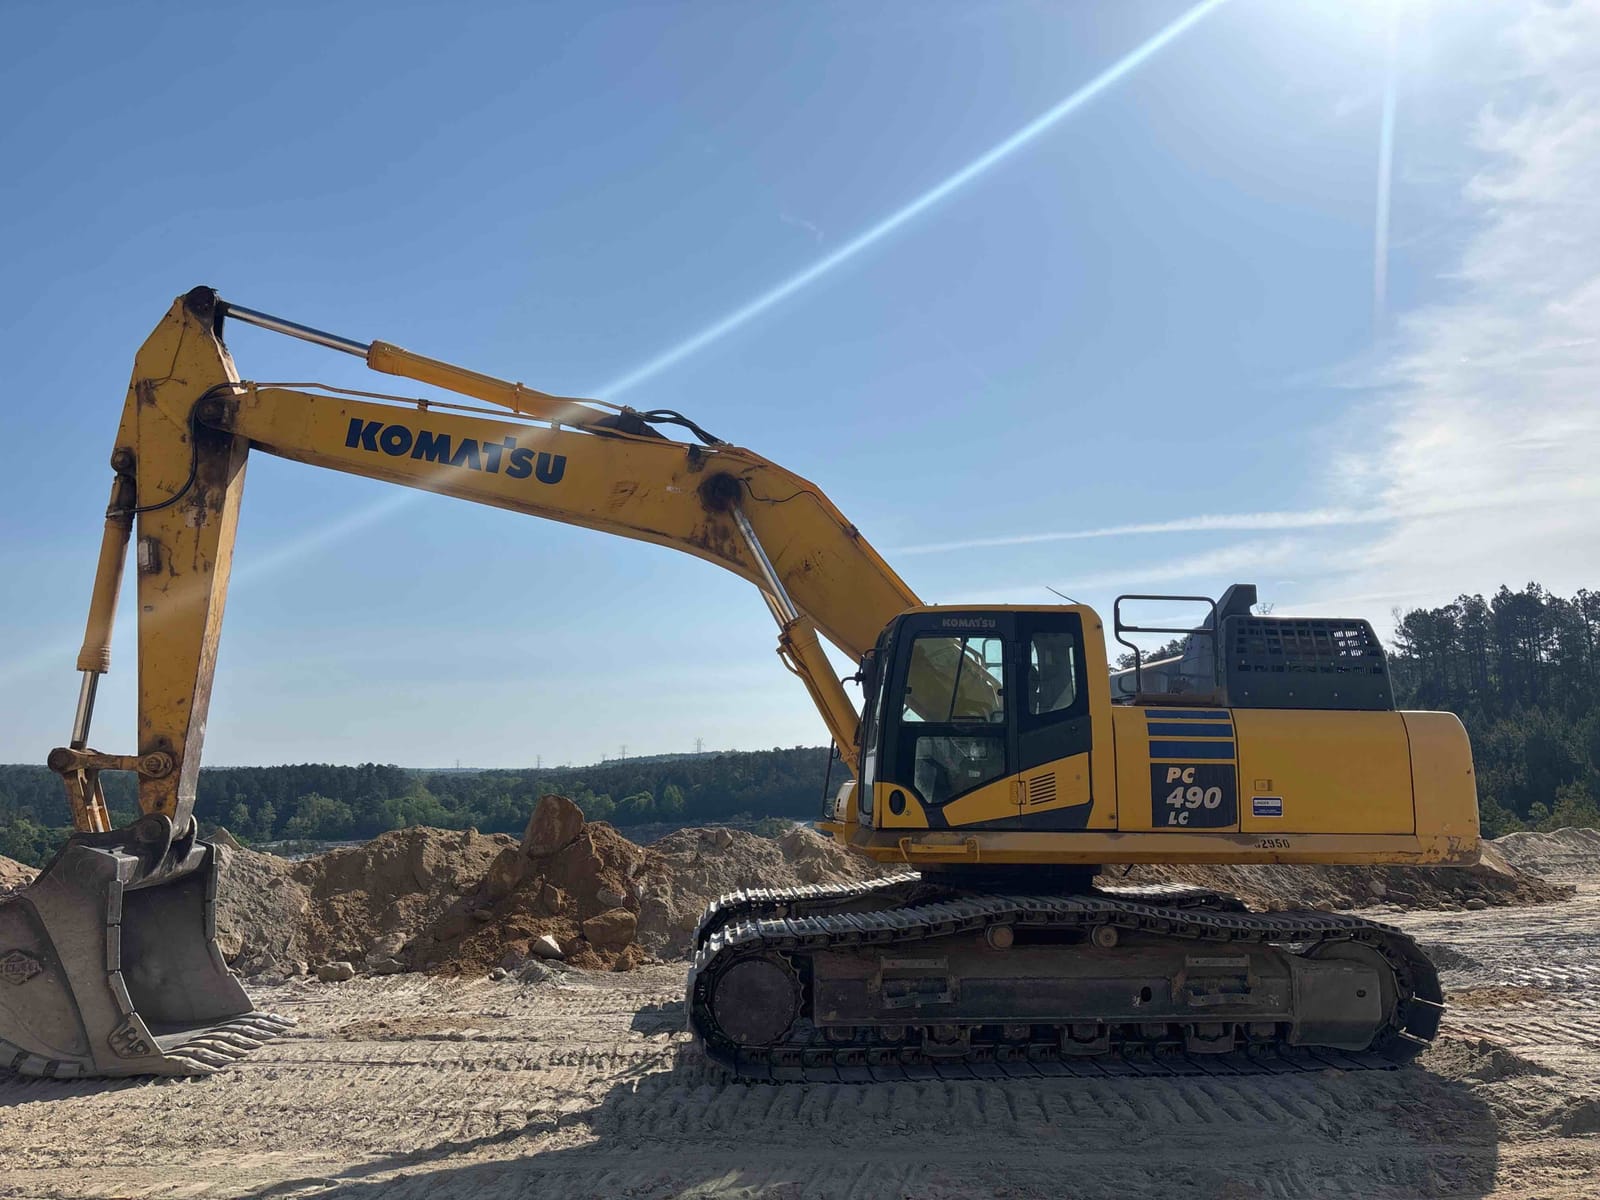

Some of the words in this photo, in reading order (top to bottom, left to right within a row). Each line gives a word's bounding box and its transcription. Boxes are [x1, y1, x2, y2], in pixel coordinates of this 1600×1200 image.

[345, 418, 567, 484] KOMATSU
[942, 617, 996, 628] KOMATSU
[1166, 767, 1195, 783] PC
[1166, 786, 1222, 809] 490
[1168, 811, 1189, 825] LC
